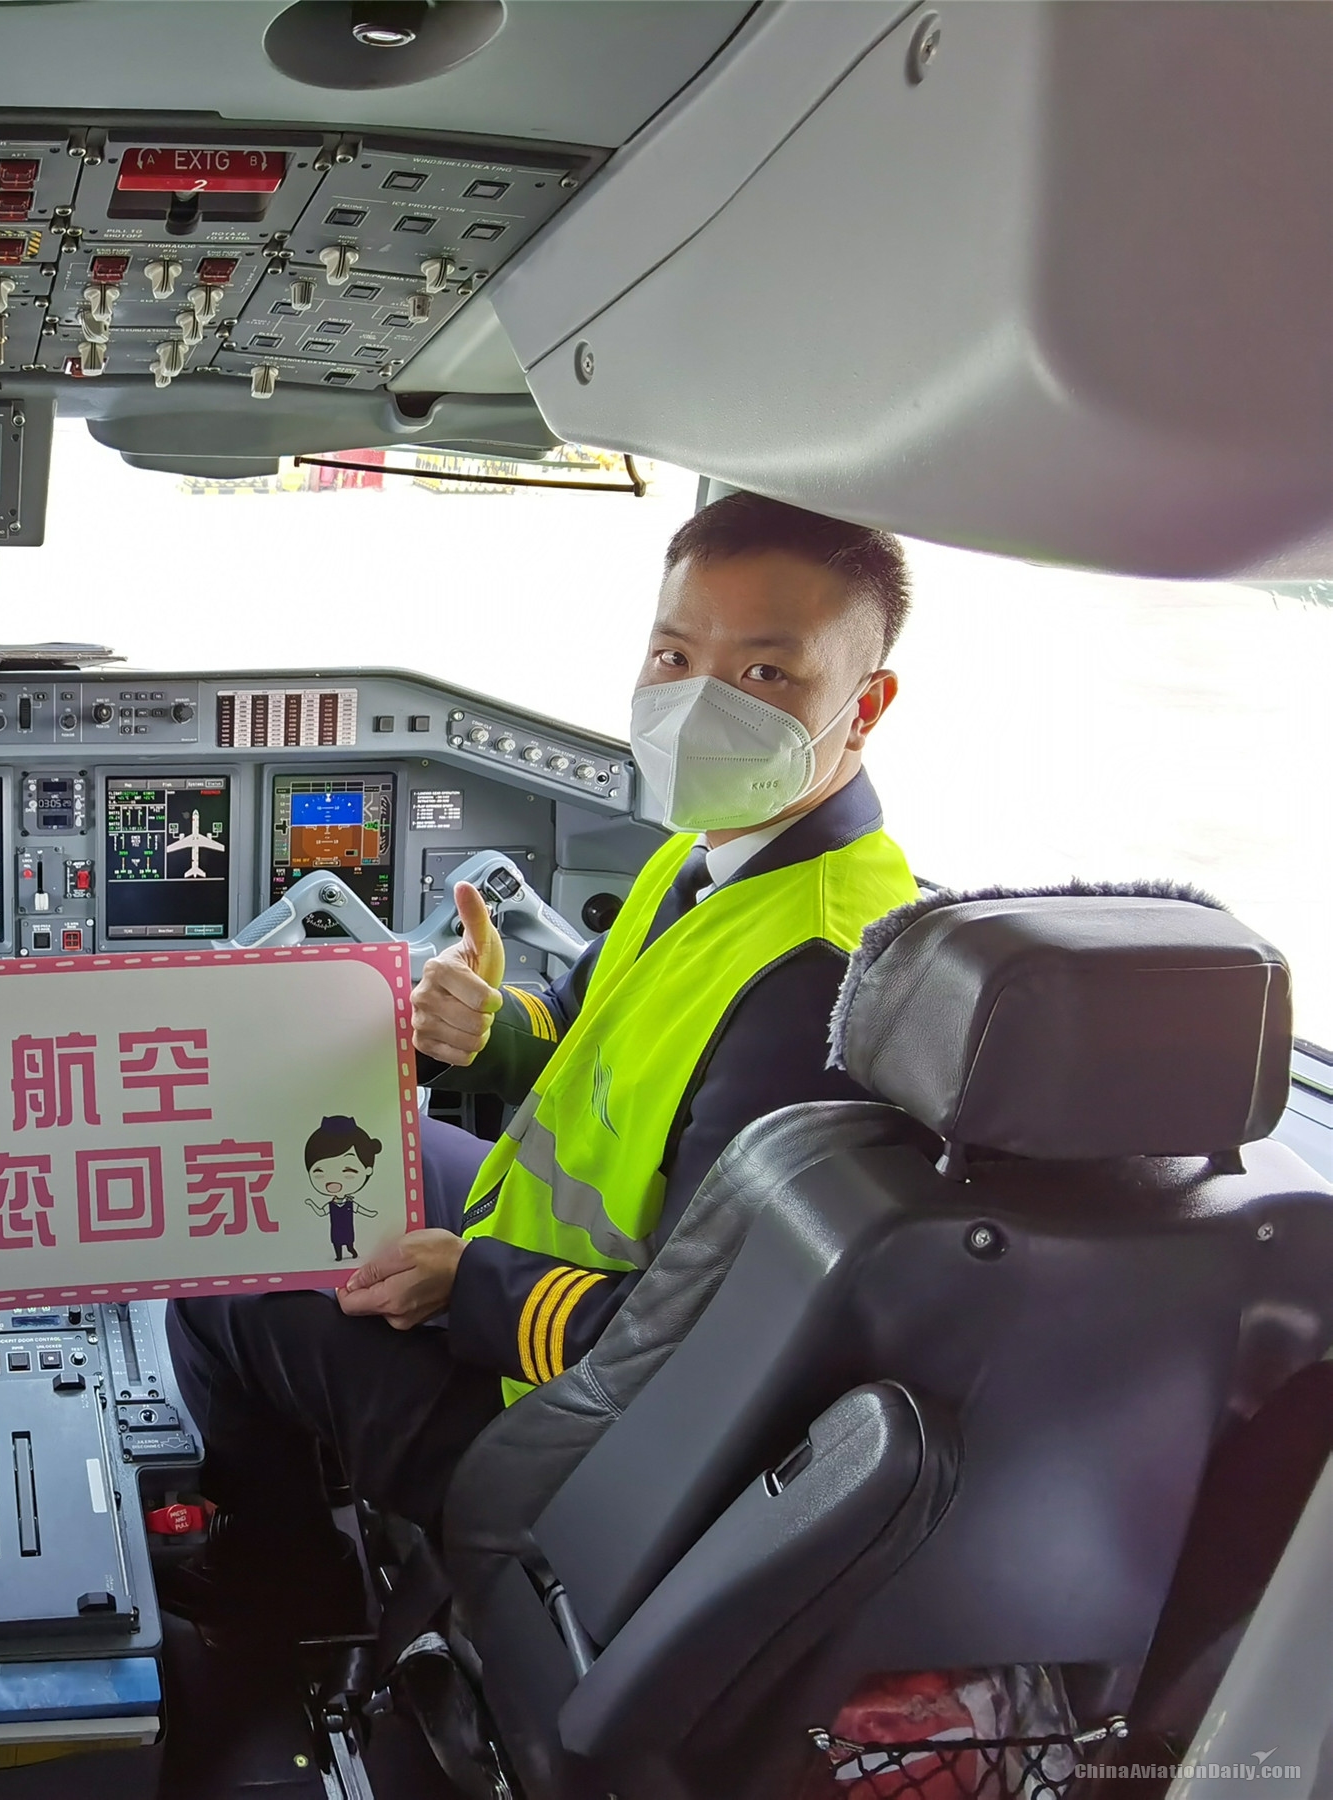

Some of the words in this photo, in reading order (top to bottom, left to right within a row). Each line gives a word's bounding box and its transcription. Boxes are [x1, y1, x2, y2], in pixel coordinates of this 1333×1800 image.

[146, 154, 155, 165] A
[174, 150, 230, 171] EXTG
[250, 155, 258, 166] B
[413, 157, 469, 169] WINDSHIELD
[470, 163, 514, 173] HEATING
[191, 179, 208, 191] 2
[408, 203, 466, 213] PROTECTION
[170, 1508, 187, 1518] PRESS
[175, 1516, 187, 1524] AND
[175, 1521, 189, 1530] PULL
